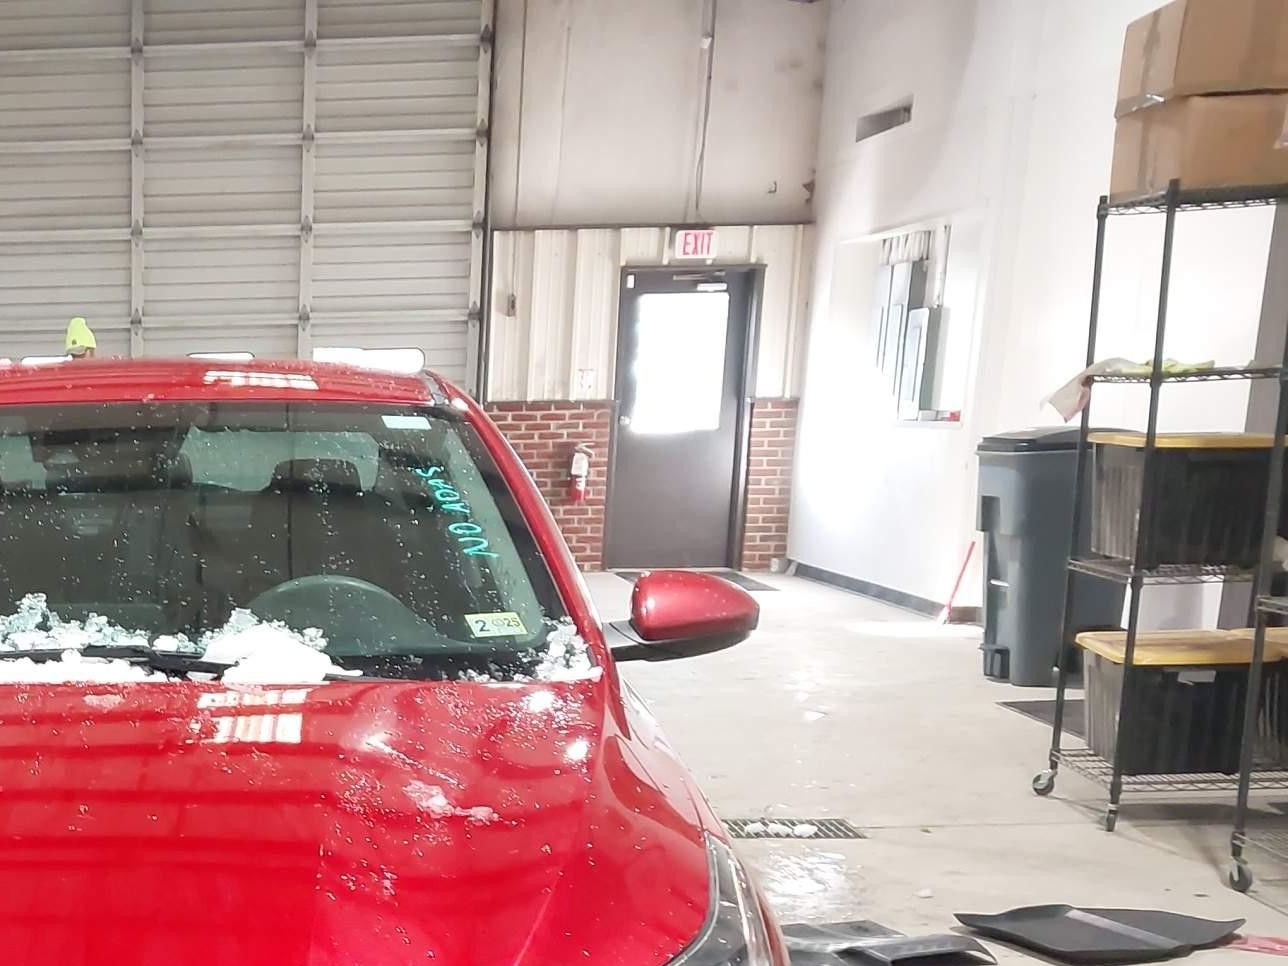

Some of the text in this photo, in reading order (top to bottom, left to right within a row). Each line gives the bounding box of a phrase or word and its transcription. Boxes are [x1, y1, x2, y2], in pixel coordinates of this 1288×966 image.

[682, 231, 714, 256] EXIT
[448, 522, 500, 559] NO
[474, 619, 491, 632] 2
